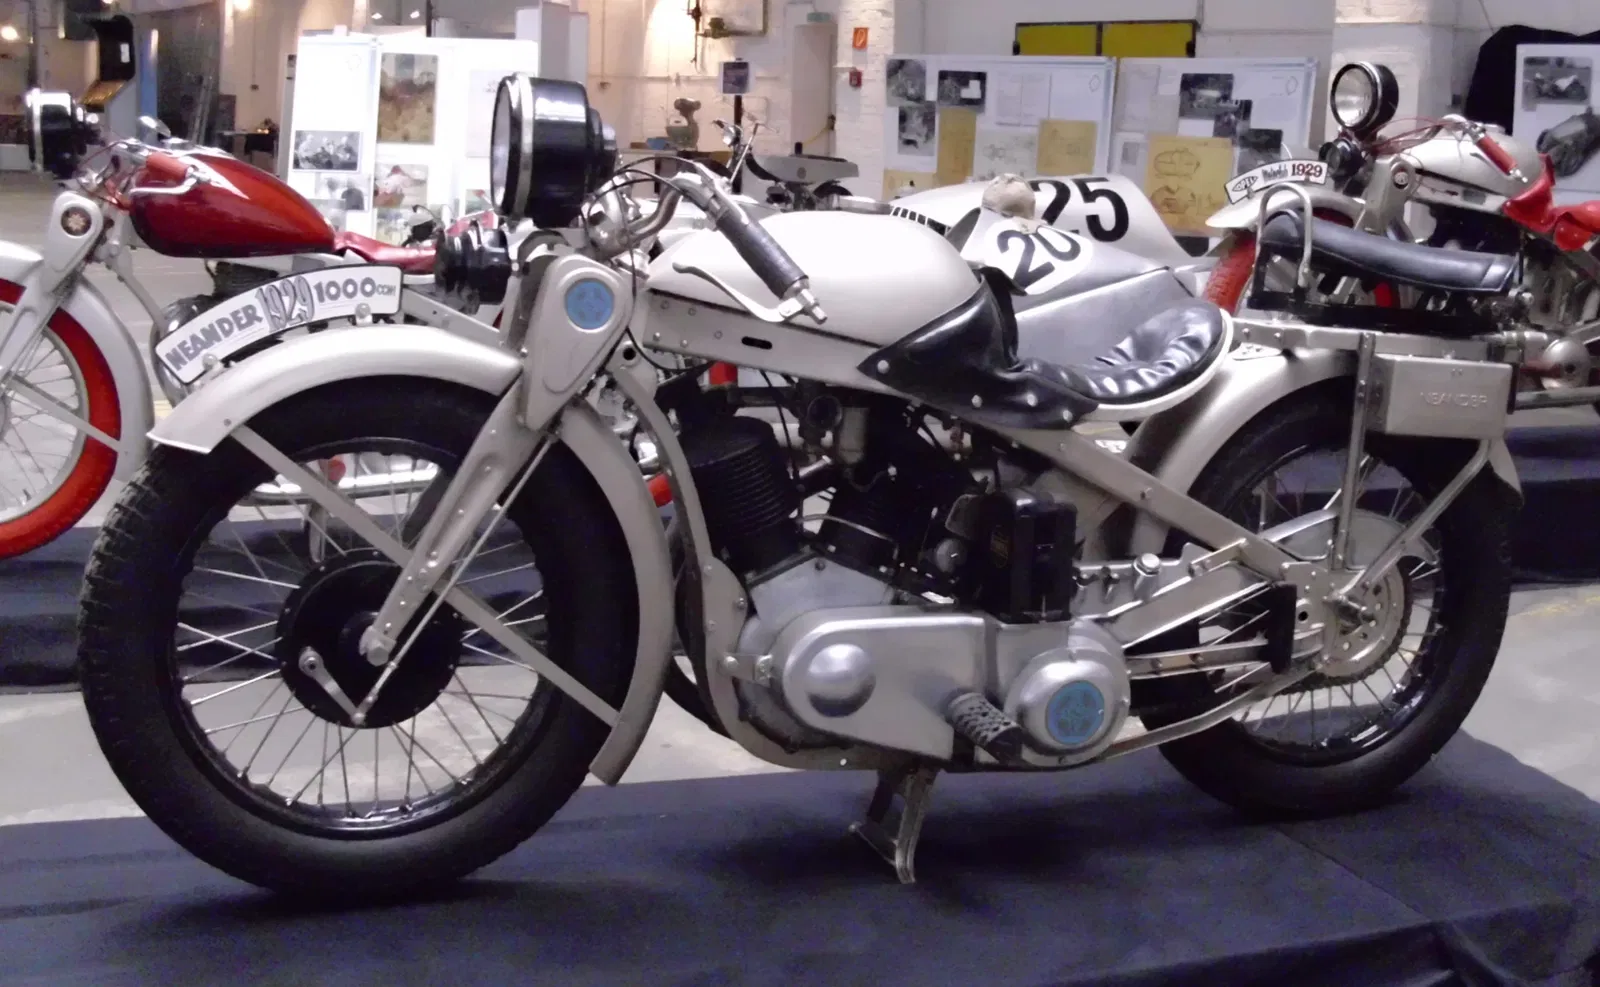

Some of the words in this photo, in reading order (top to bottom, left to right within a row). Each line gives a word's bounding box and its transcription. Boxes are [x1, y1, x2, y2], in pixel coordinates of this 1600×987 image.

[1291, 163, 1323, 178] 1929
[1028, 177, 1129, 243] 25
[996, 225, 1082, 290] 20
[164, 304, 263, 371] NEANDER
[254, 275, 316, 332] 1929
[313, 277, 377, 304] 1000
